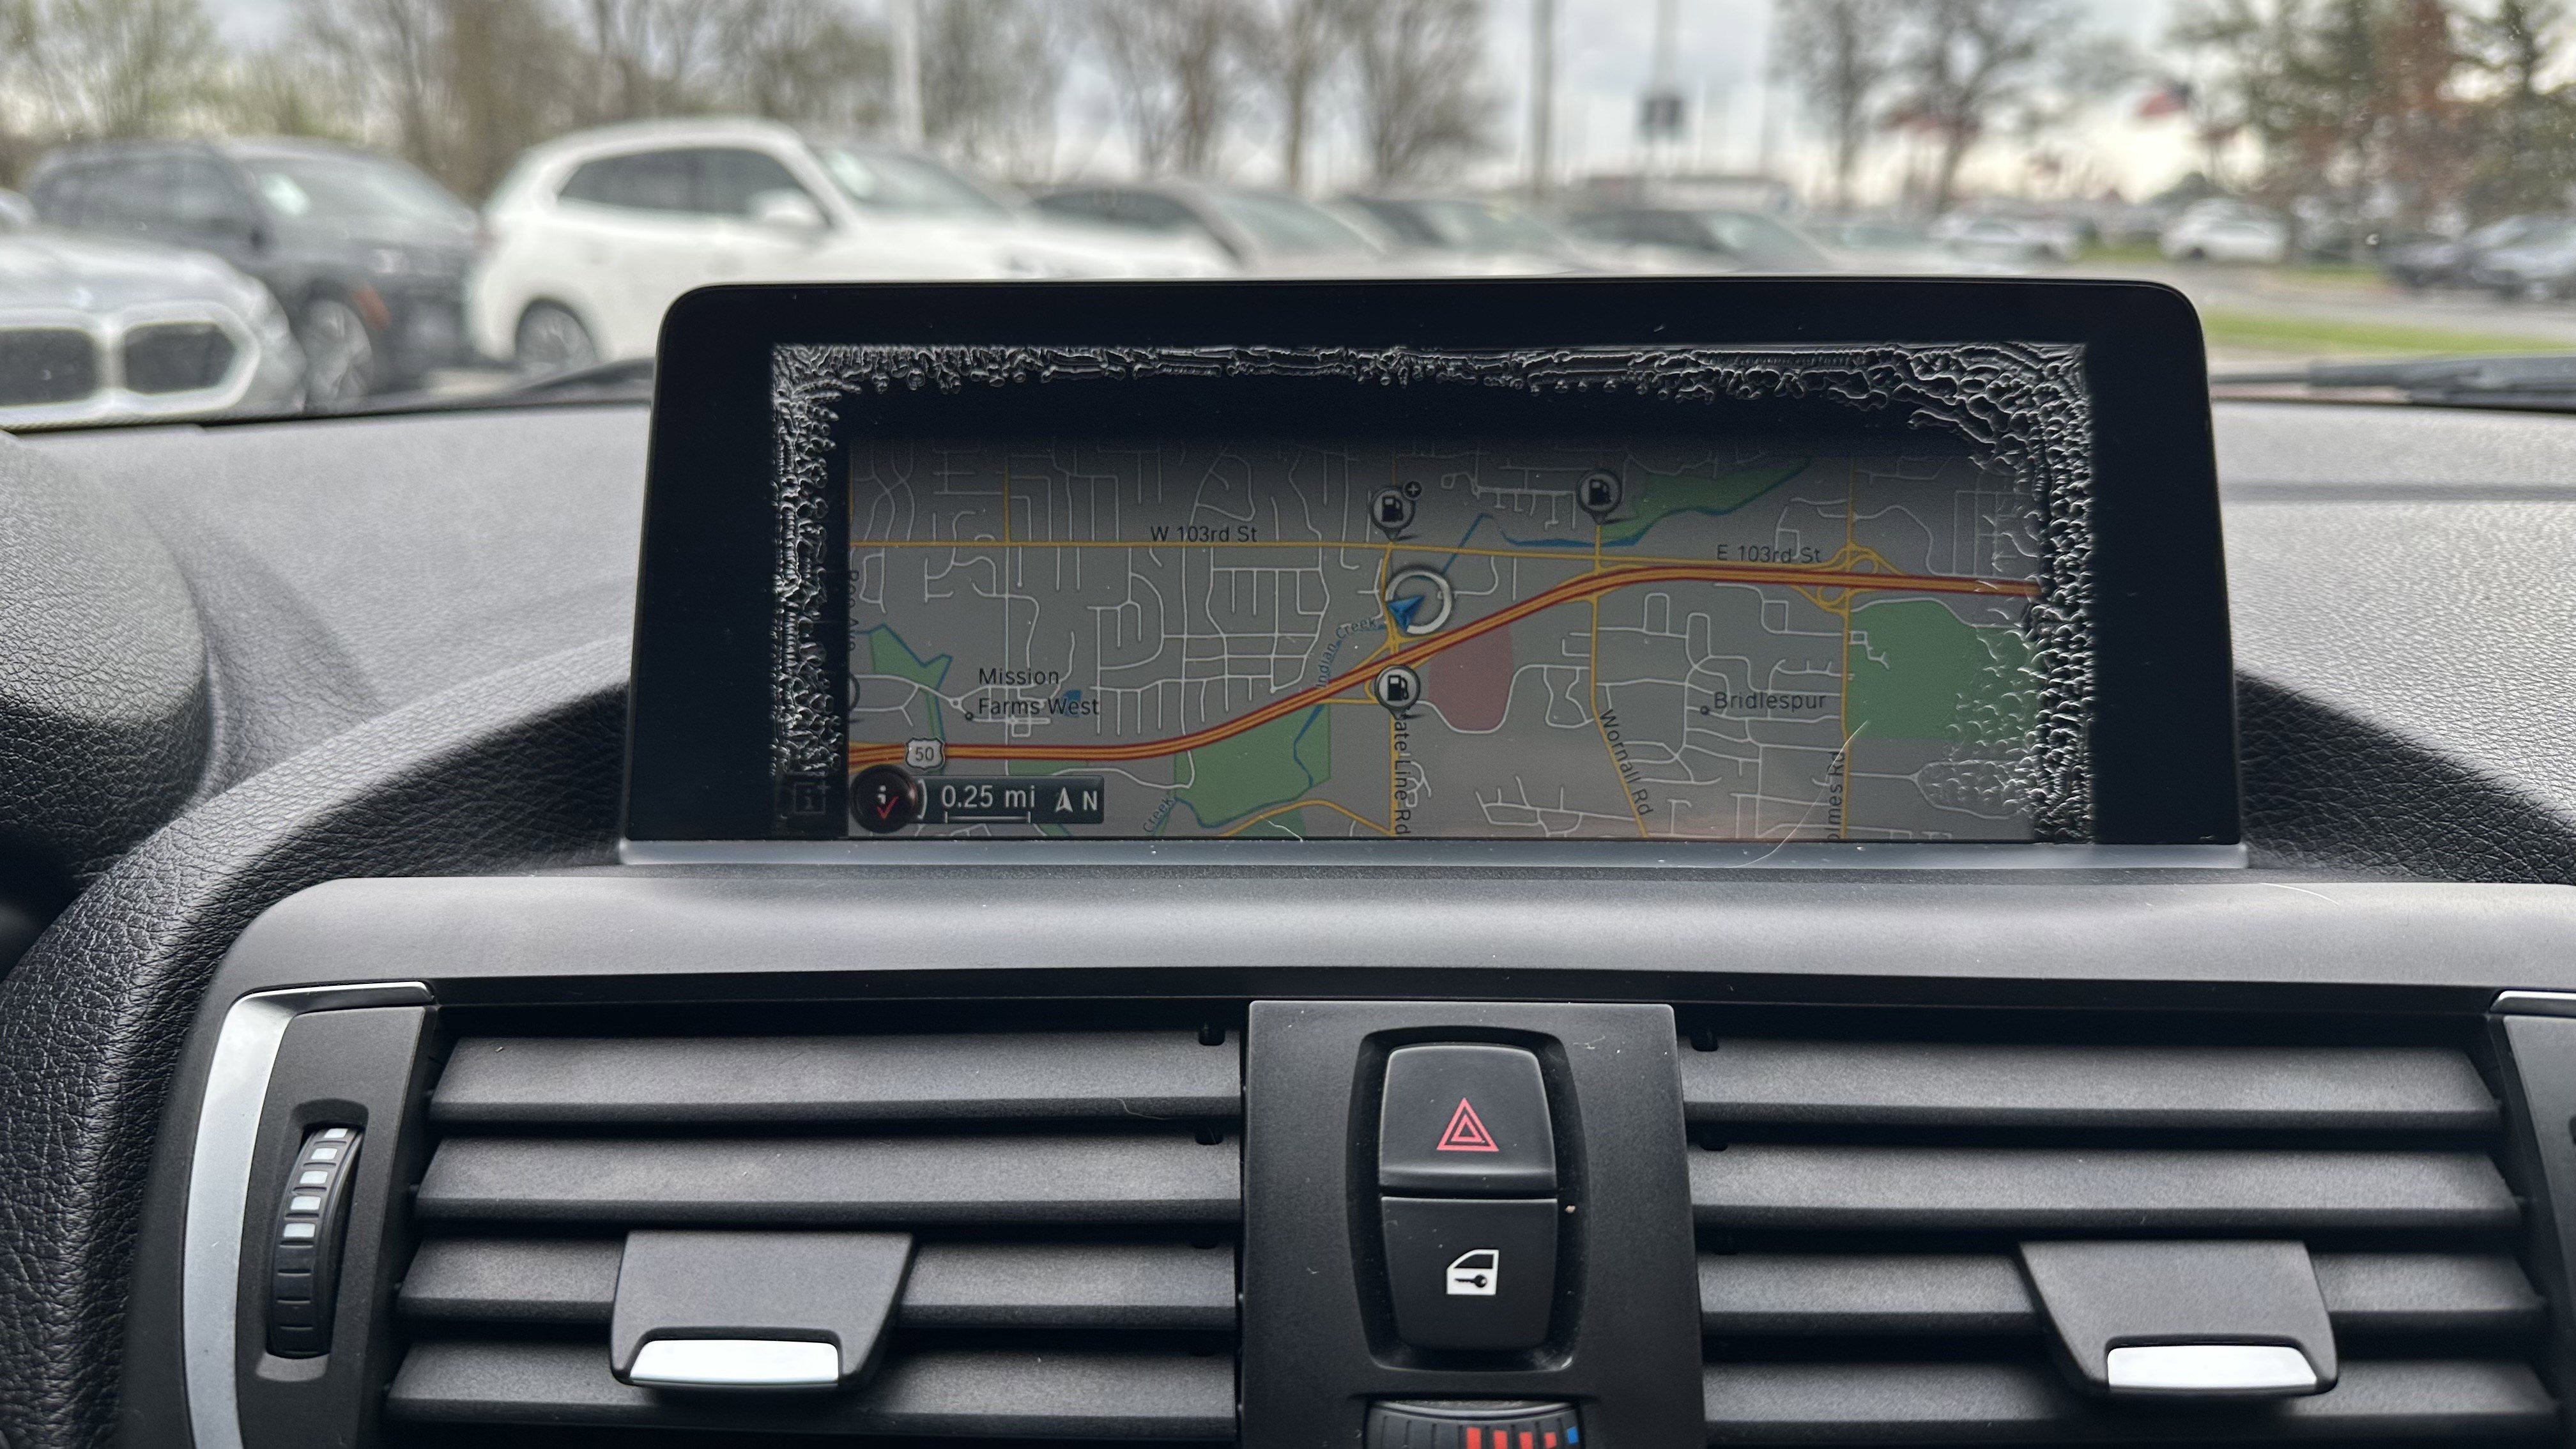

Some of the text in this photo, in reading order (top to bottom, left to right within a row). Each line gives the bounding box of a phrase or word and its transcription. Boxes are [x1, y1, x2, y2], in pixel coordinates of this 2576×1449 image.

[1150, 526, 1257, 542] W 103rd St
[1717, 544, 1820, 564] E 103rd St
[1335, 617, 1376, 639] Creek
[978, 668, 1059, 685] Mission
[978, 698, 1100, 715] Farms West
[1714, 692, 1827, 711] Bridlespur
[915, 747, 935, 762] 50
[1600, 709, 1653, 816] Wornall Rd
[1394, 719, 1411, 835] ate Line Rd
[942, 785, 1036, 808] 0.25 mi
[1083, 791, 1098, 810] N
[1824, 751, 1845, 839] olmes Rd
[1143, 798, 1173, 832] Creek
